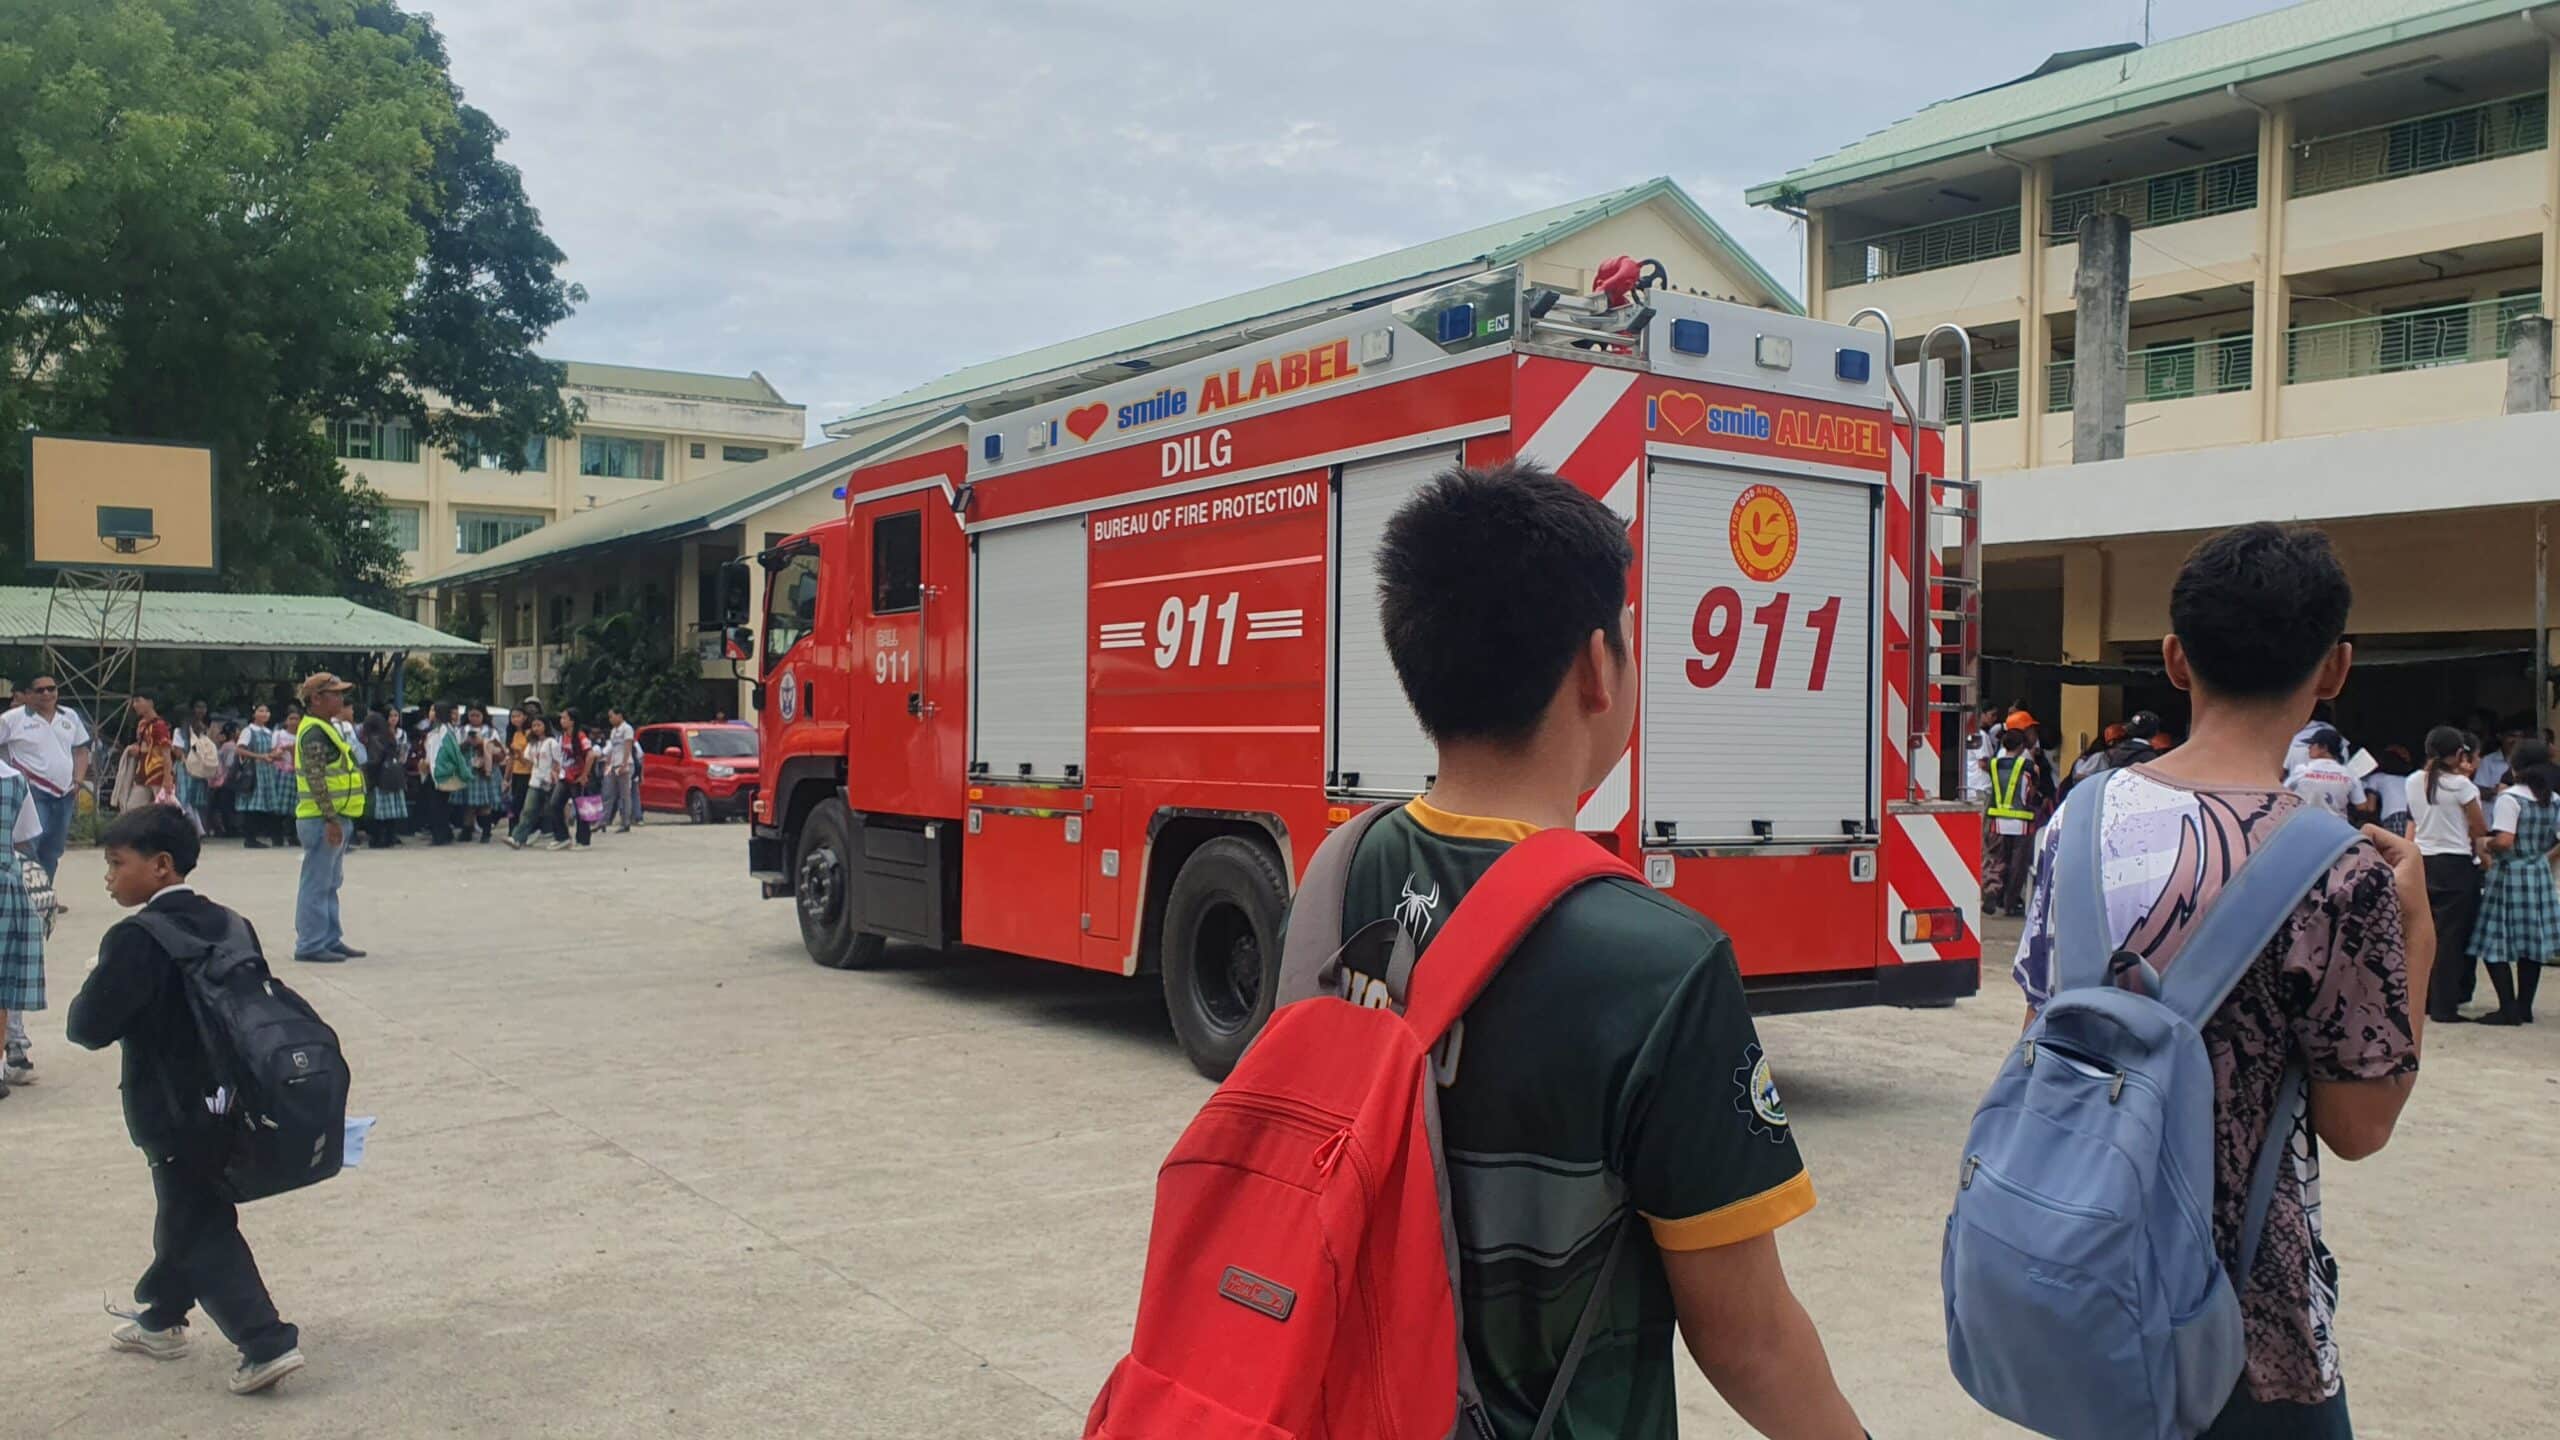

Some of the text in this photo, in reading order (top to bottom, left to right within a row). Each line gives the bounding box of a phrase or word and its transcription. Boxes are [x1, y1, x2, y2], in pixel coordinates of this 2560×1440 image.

[1117, 387, 1188, 430] smile
[1196, 339, 1359, 415] ALABEL
[1161, 429, 1233, 478] DILG
[1645, 396, 1887, 459] I smile ALABEL
[1094, 482, 1319, 542] BUREAU OF FIRE PROTECTION
[1154, 592, 1239, 669] 911
[1685, 586, 1842, 692] 911
[875, 650, 910, 685] 911
